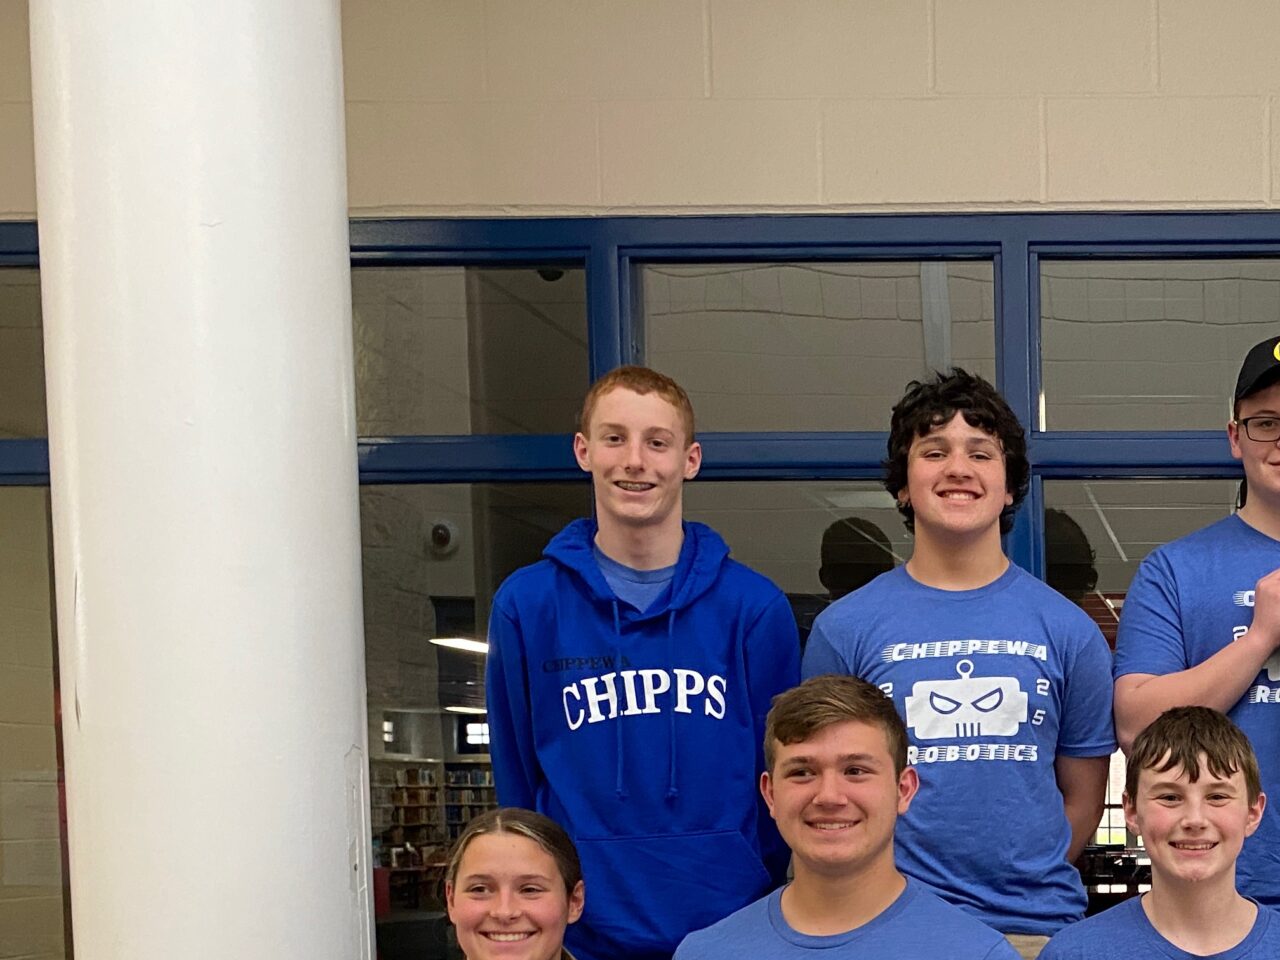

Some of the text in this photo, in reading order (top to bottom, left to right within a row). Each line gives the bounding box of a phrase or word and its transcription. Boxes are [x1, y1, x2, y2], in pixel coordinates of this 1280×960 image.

[881, 640, 1048, 663] CHIPPEWA
[1037, 679, 1050, 696] 2
[563, 669, 727, 731] CHIPPS
[1032, 709, 1046, 726] 5
[906, 744, 1038, 765] ROBOTICS
